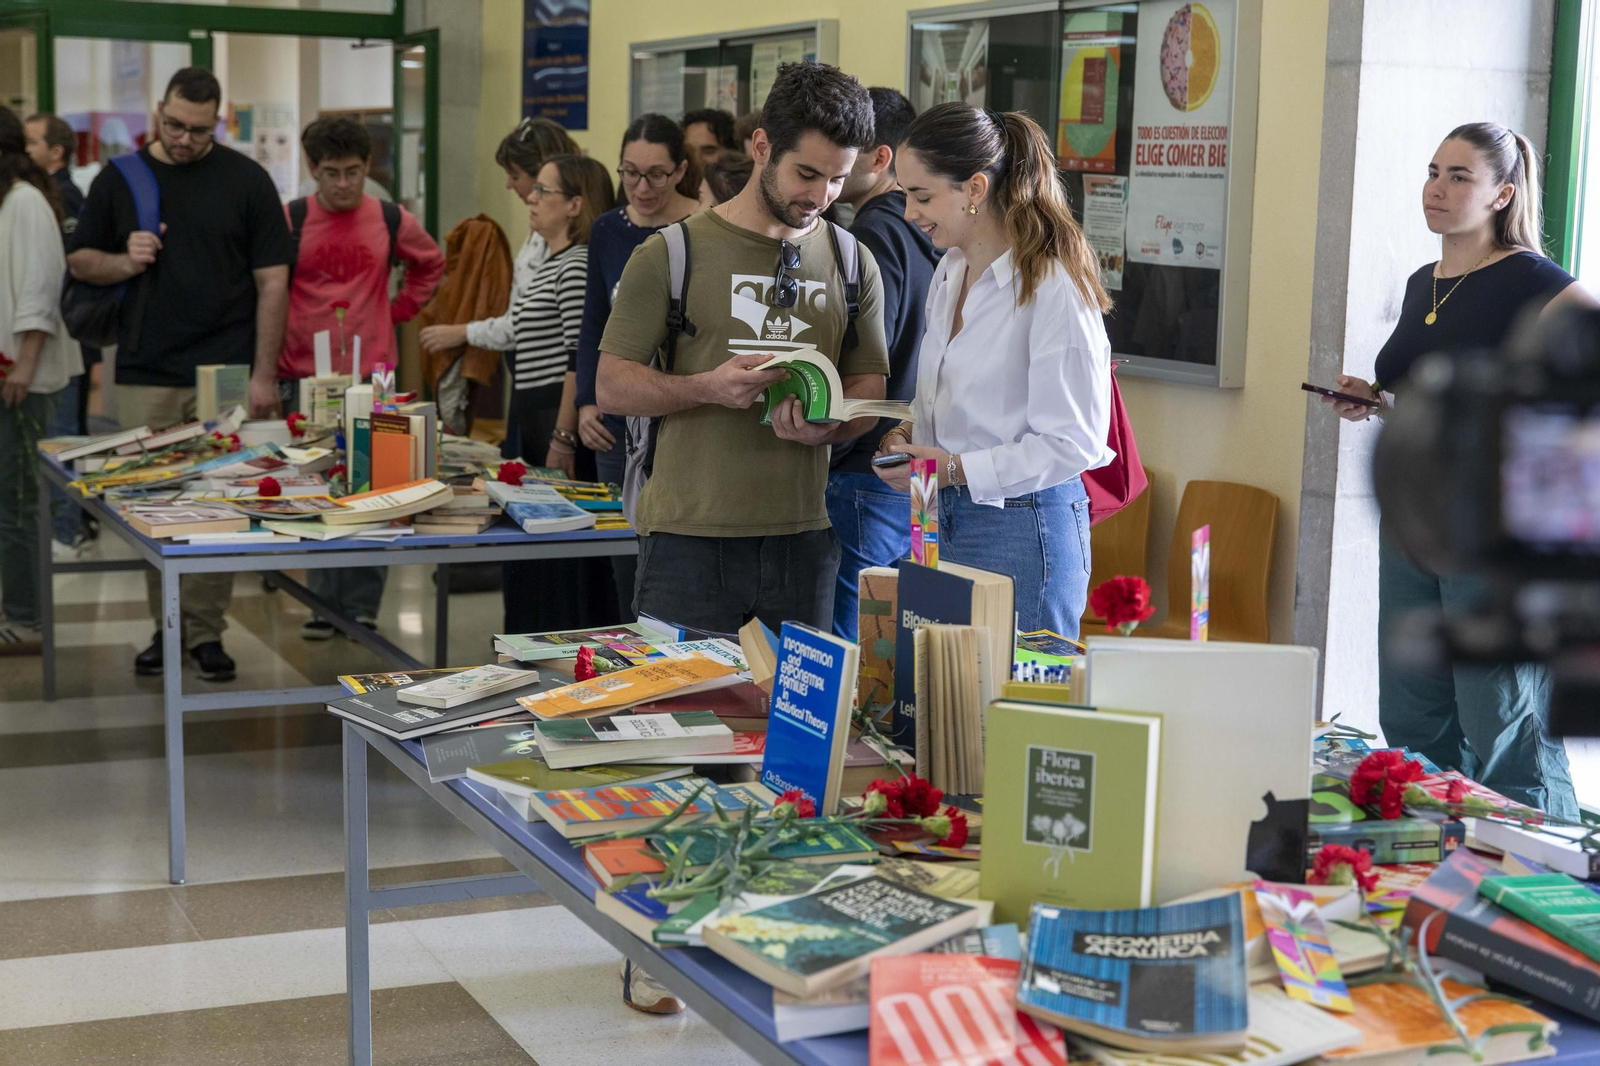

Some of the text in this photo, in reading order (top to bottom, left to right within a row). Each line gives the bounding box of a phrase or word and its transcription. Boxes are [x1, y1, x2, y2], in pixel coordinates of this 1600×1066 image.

[1138, 126, 1152, 139] TODO
[1154, 126, 1161, 140] ES
[1162, 123, 1190, 140] CUESTIÓN
[1191, 126, 1199, 140] DE
[1136, 144, 1164, 166] ELIGE
[1166, 144, 1205, 166] COMER
[1155, 215, 1172, 236] Elige
[783, 636, 833, 668] INFORMATION
[788, 654, 802, 667] and
[779, 674, 808, 697] FAMILIES
[780, 662, 824, 692] EXPONENTIAL
[782, 688, 789, 700] in
[775, 697, 828, 734] Statistical Theory
[1042, 750, 1080, 770] Flora
[766, 770, 776, 784] Ole
[1036, 766, 1085, 789] iberica
[1084, 930, 1221, 948] GEOMETRIA
[1084, 944, 1209, 959] ANALITICA
